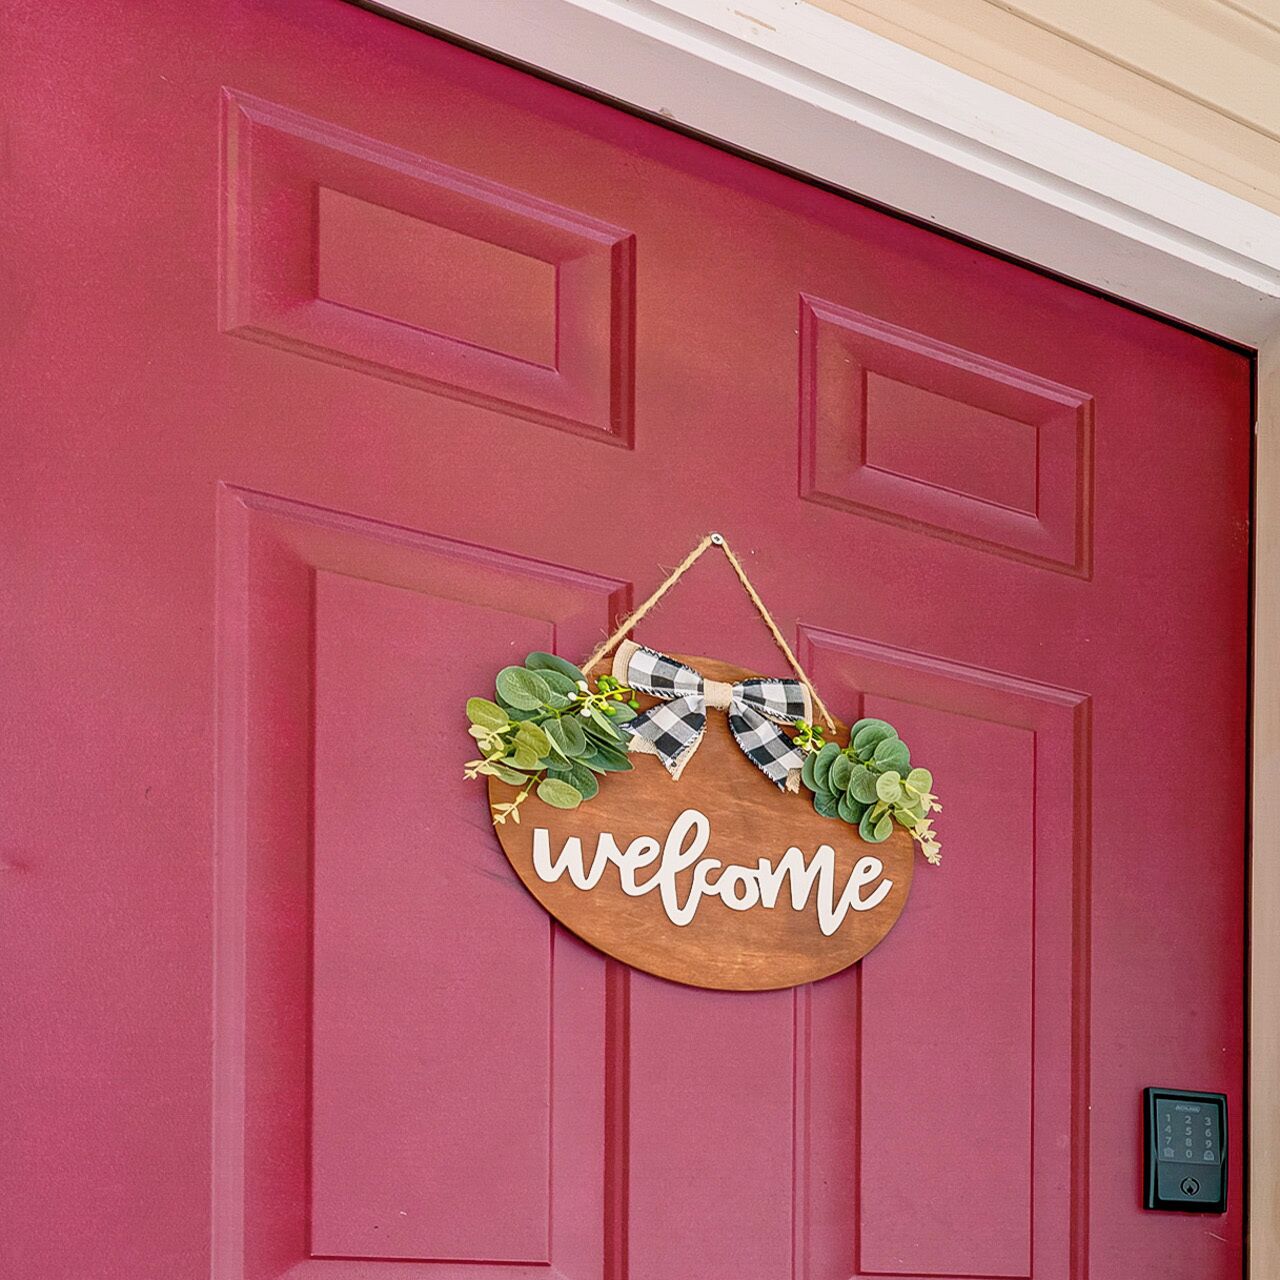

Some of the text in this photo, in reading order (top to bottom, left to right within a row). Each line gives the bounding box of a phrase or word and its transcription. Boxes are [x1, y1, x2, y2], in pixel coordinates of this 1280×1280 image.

[532, 809, 893, 937] welcome
[1165, 1113, 1212, 1126] 1 2 3
[1164, 1125, 1212, 1138] 4 5 6
[1165, 1136, 1212, 1149] 7 8 9
[1185, 1149, 1193, 1159] 0
